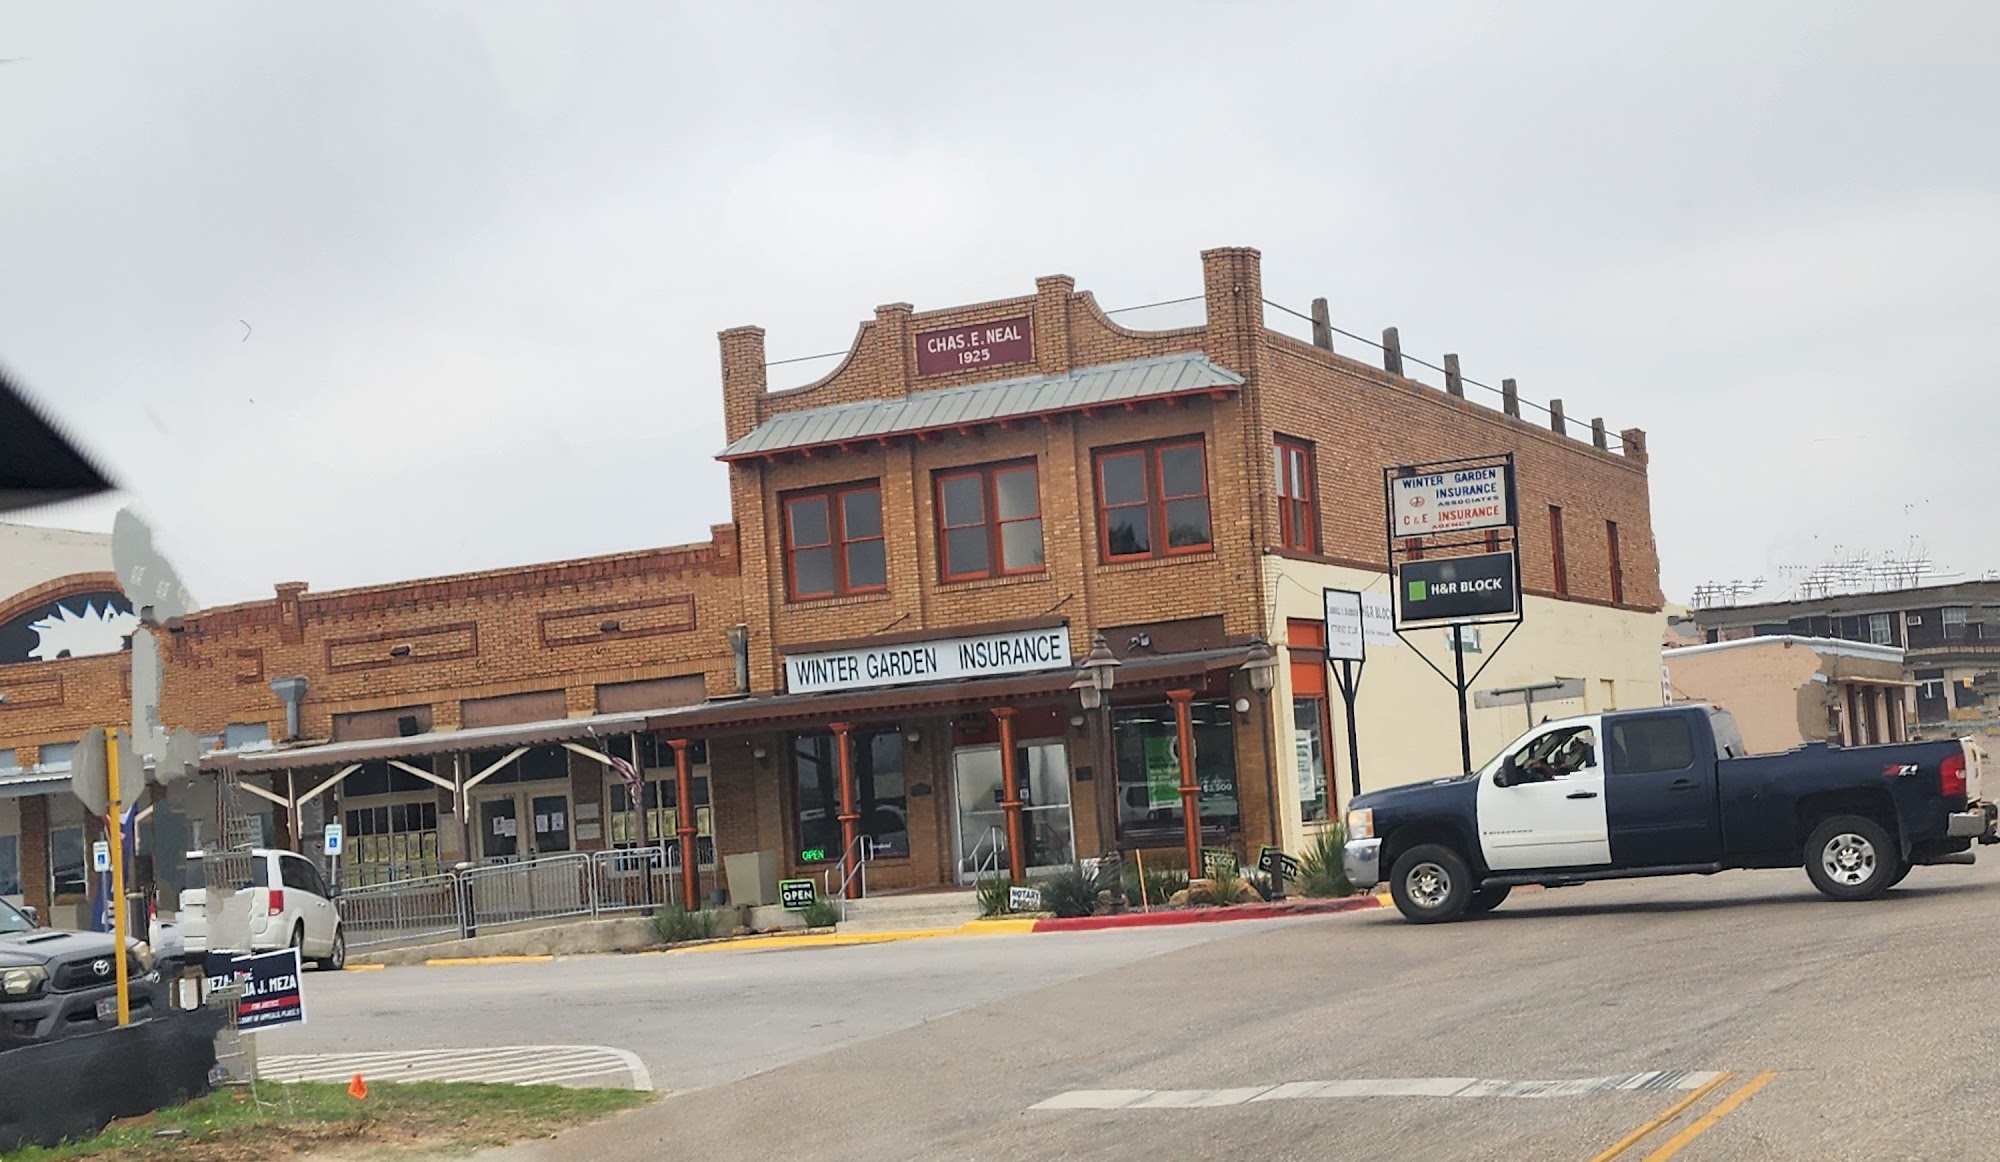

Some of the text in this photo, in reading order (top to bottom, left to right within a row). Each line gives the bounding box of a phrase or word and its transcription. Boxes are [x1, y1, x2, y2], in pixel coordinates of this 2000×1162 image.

[986, 325, 1021, 344] NEAL
[958, 348, 990, 364] 1925
[1402, 469, 1496, 489] WINTER GARDEN
[1436, 483, 1497, 499] INSURANCE
[1438, 495, 1499, 506] ASSOCIATES
[1404, 516, 1410, 525] C
[1422, 514, 1428, 523] E
[1438, 506, 1499, 522] INSURANCE
[1432, 521, 1472, 530] AGENCY
[1431, 578, 1502, 595] H&R BLOCK
[795, 635, 1061, 685] WINTER GARDEN INSURANCE
[802, 849, 824, 861] OPEN
[1262, 856, 1296, 876] OEN
[784, 890, 812, 901] OPEN
[1012, 890, 1039, 900] NOTARY
[257, 979, 268, 994] J.
[269, 974, 297, 993] MEZA
